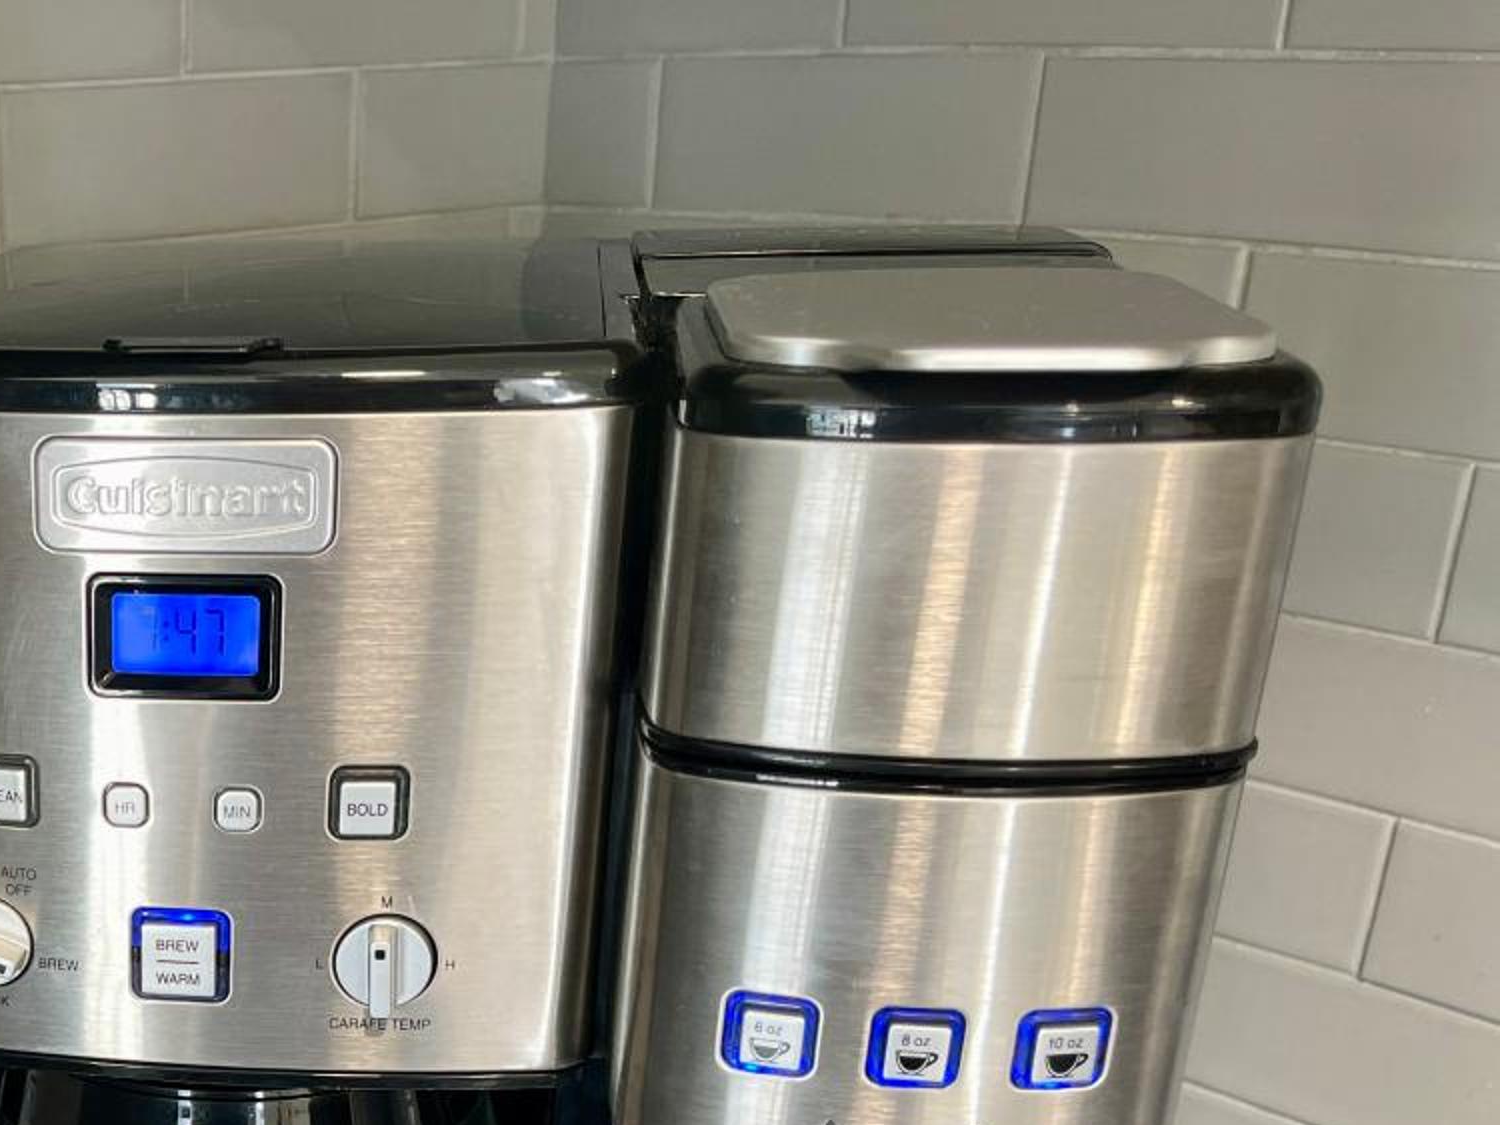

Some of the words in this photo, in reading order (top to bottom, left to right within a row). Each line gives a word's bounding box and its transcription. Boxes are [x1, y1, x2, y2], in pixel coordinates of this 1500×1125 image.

[67, 475, 308, 518] Cuisinart
[114, 802, 136, 814] HR
[223, 805, 251, 818] MIN
[346, 803, 388, 817] BOLD
[1, 866, 37, 881] AUTO
[5, 884, 32, 896] OFF
[381, 896, 393, 908] M
[156, 939, 199, 952] BREW
[38, 957, 78, 971] BREW
[315, 959, 323, 970] L
[445, 959, 455, 970] H
[155, 973, 200, 986] WARM
[329, 1017, 387, 1031] CARAFE
[392, 1018, 432, 1031] TEMP
[1049, 1037, 1063, 1049] 10
